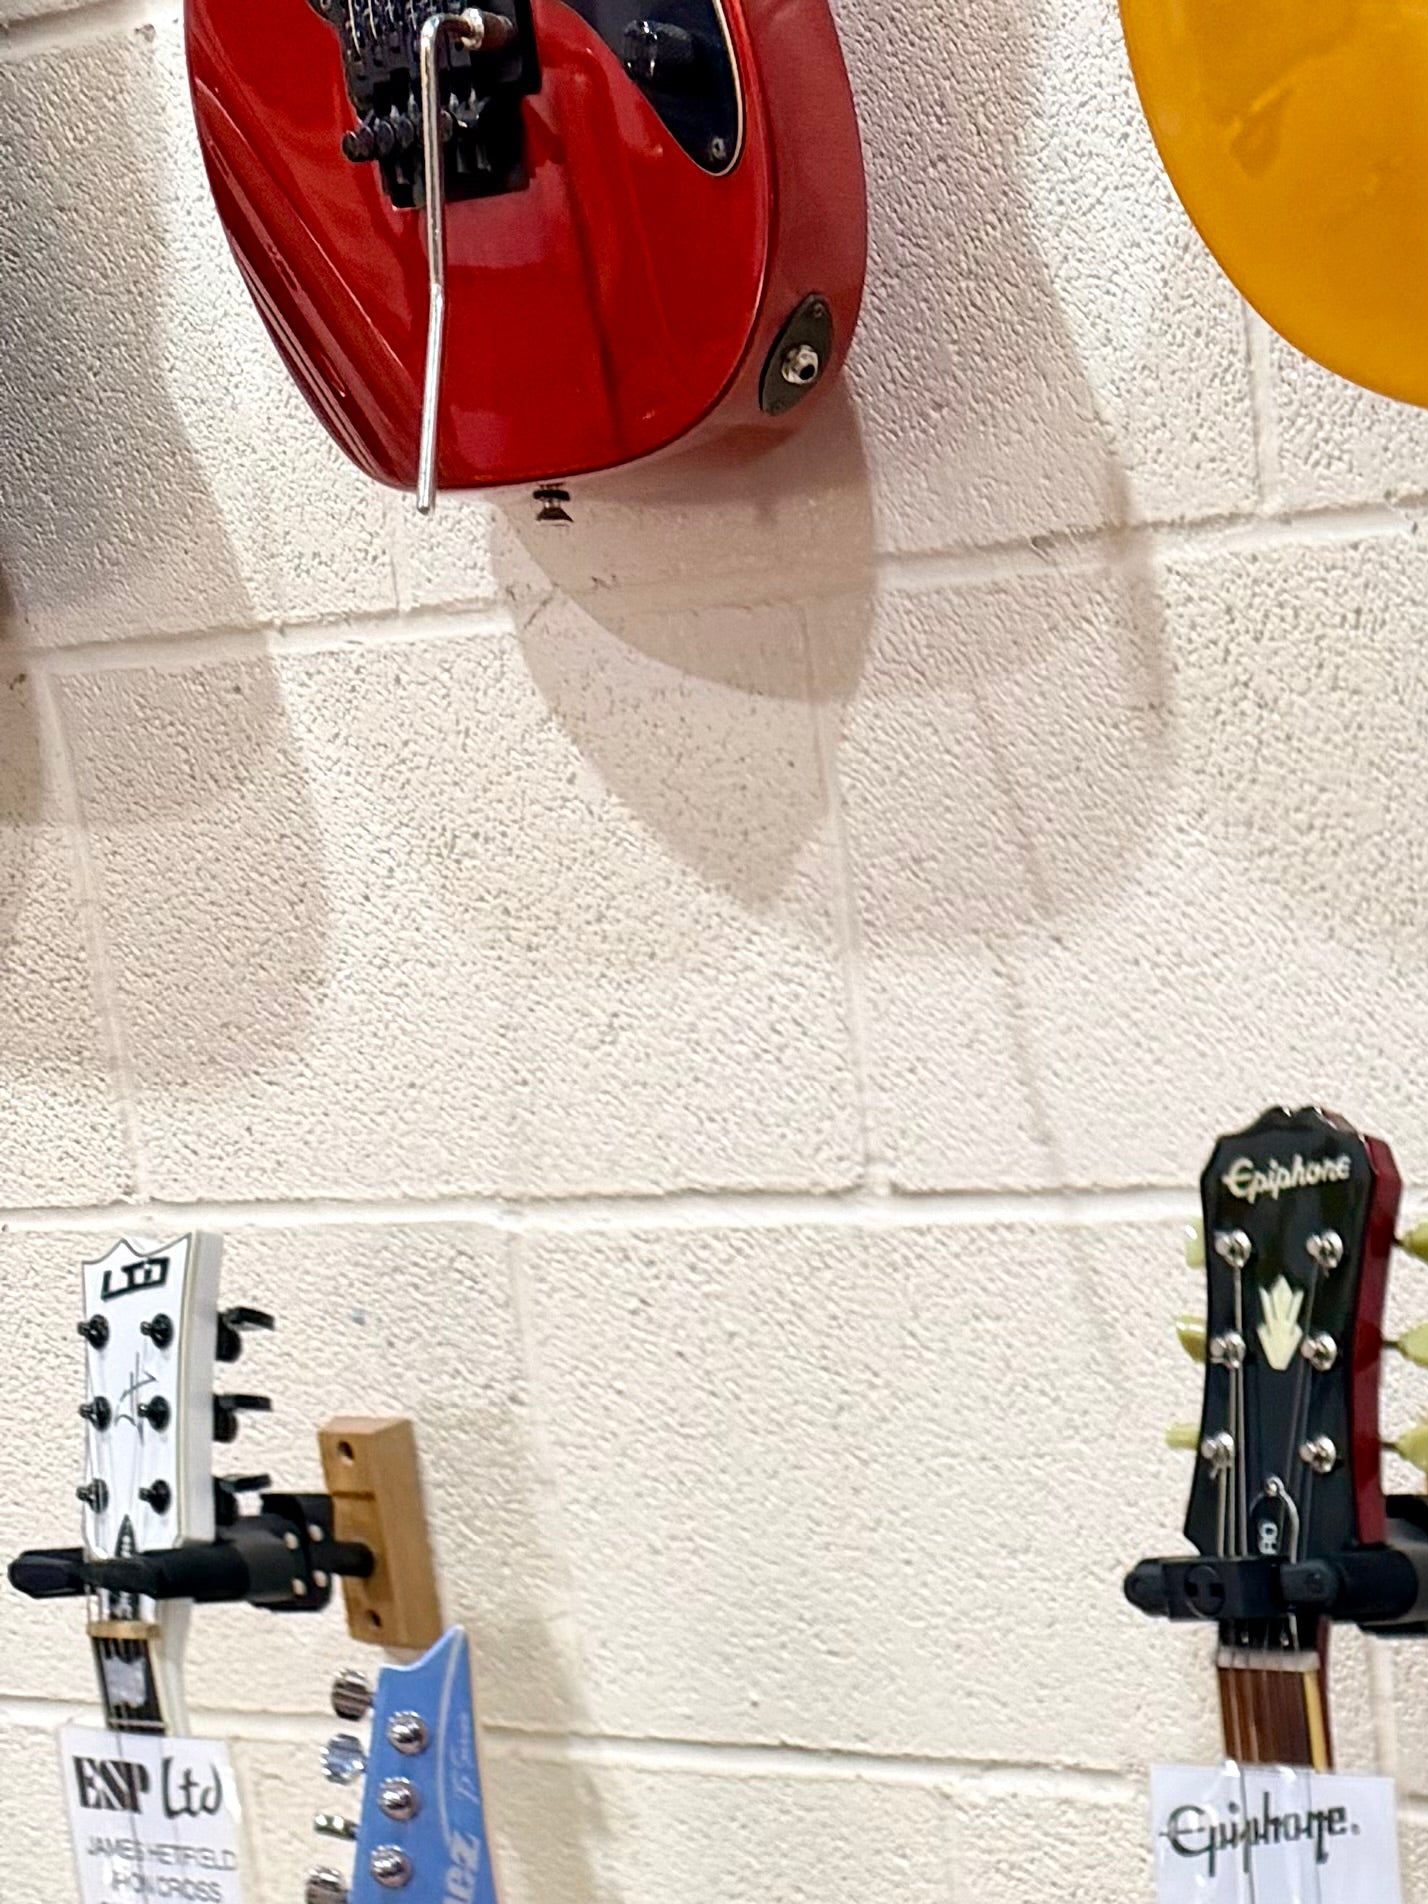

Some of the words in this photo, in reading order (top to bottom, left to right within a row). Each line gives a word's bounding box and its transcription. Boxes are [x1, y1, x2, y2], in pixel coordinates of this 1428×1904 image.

[1221, 1153, 1351, 1204] Epiphone
[1258, 1520, 1279, 1557] RO
[72, 1755, 150, 1814] ESP
[1159, 1791, 1348, 1877] Epiphone
